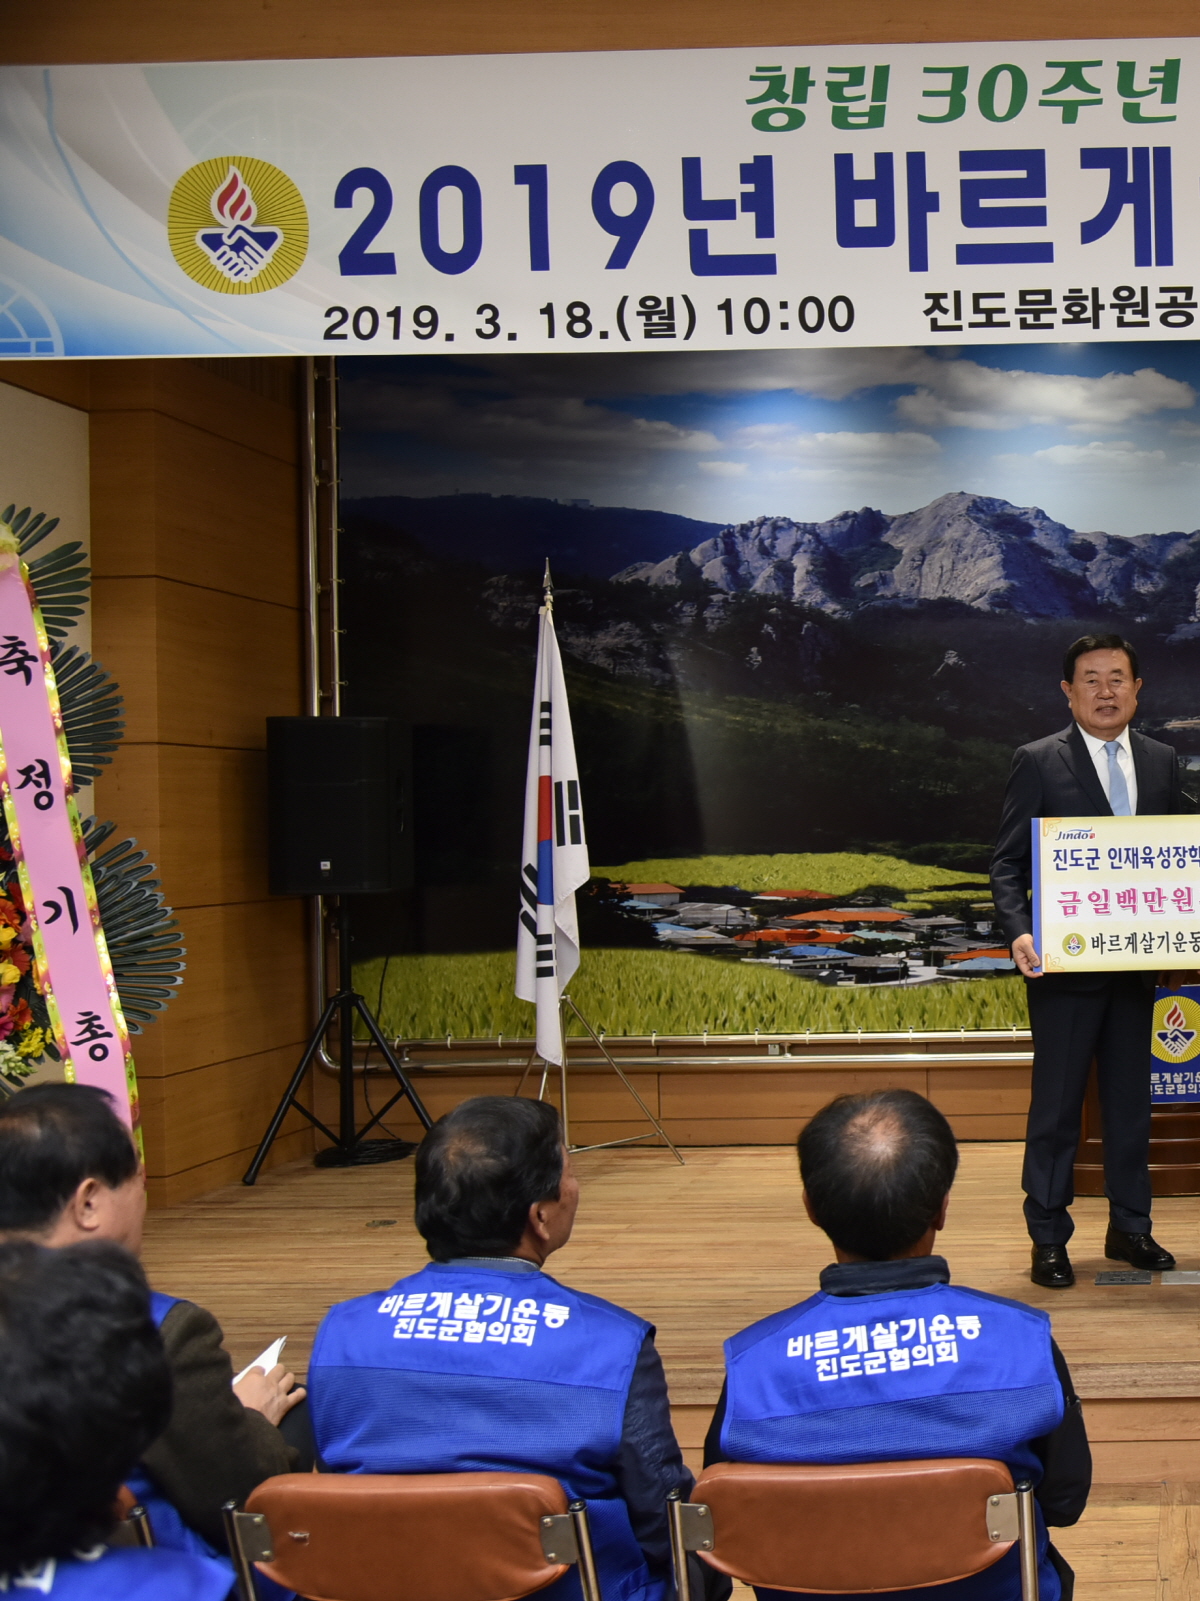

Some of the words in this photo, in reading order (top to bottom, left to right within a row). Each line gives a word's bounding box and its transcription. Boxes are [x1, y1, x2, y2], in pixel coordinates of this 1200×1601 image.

[747, 64, 891, 132] 창립
[917, 58, 1182, 124] 30주년
[334, 155, 778, 277] 2019년
[323, 304, 455, 342] 2019.
[475, 303, 518, 341] 3.
[717, 295, 855, 336] 10:00
[1055, 831, 1089, 841] Jindo
[1052, 847, 1101, 871] 진도군
[377, 1291, 570, 1329] 바르게살기운동
[393, 1317, 536, 1347] 진도군협의회
[787, 1314, 982, 1360] 바르게살기운동
[816, 1341, 959, 1382] 진도군협의회
